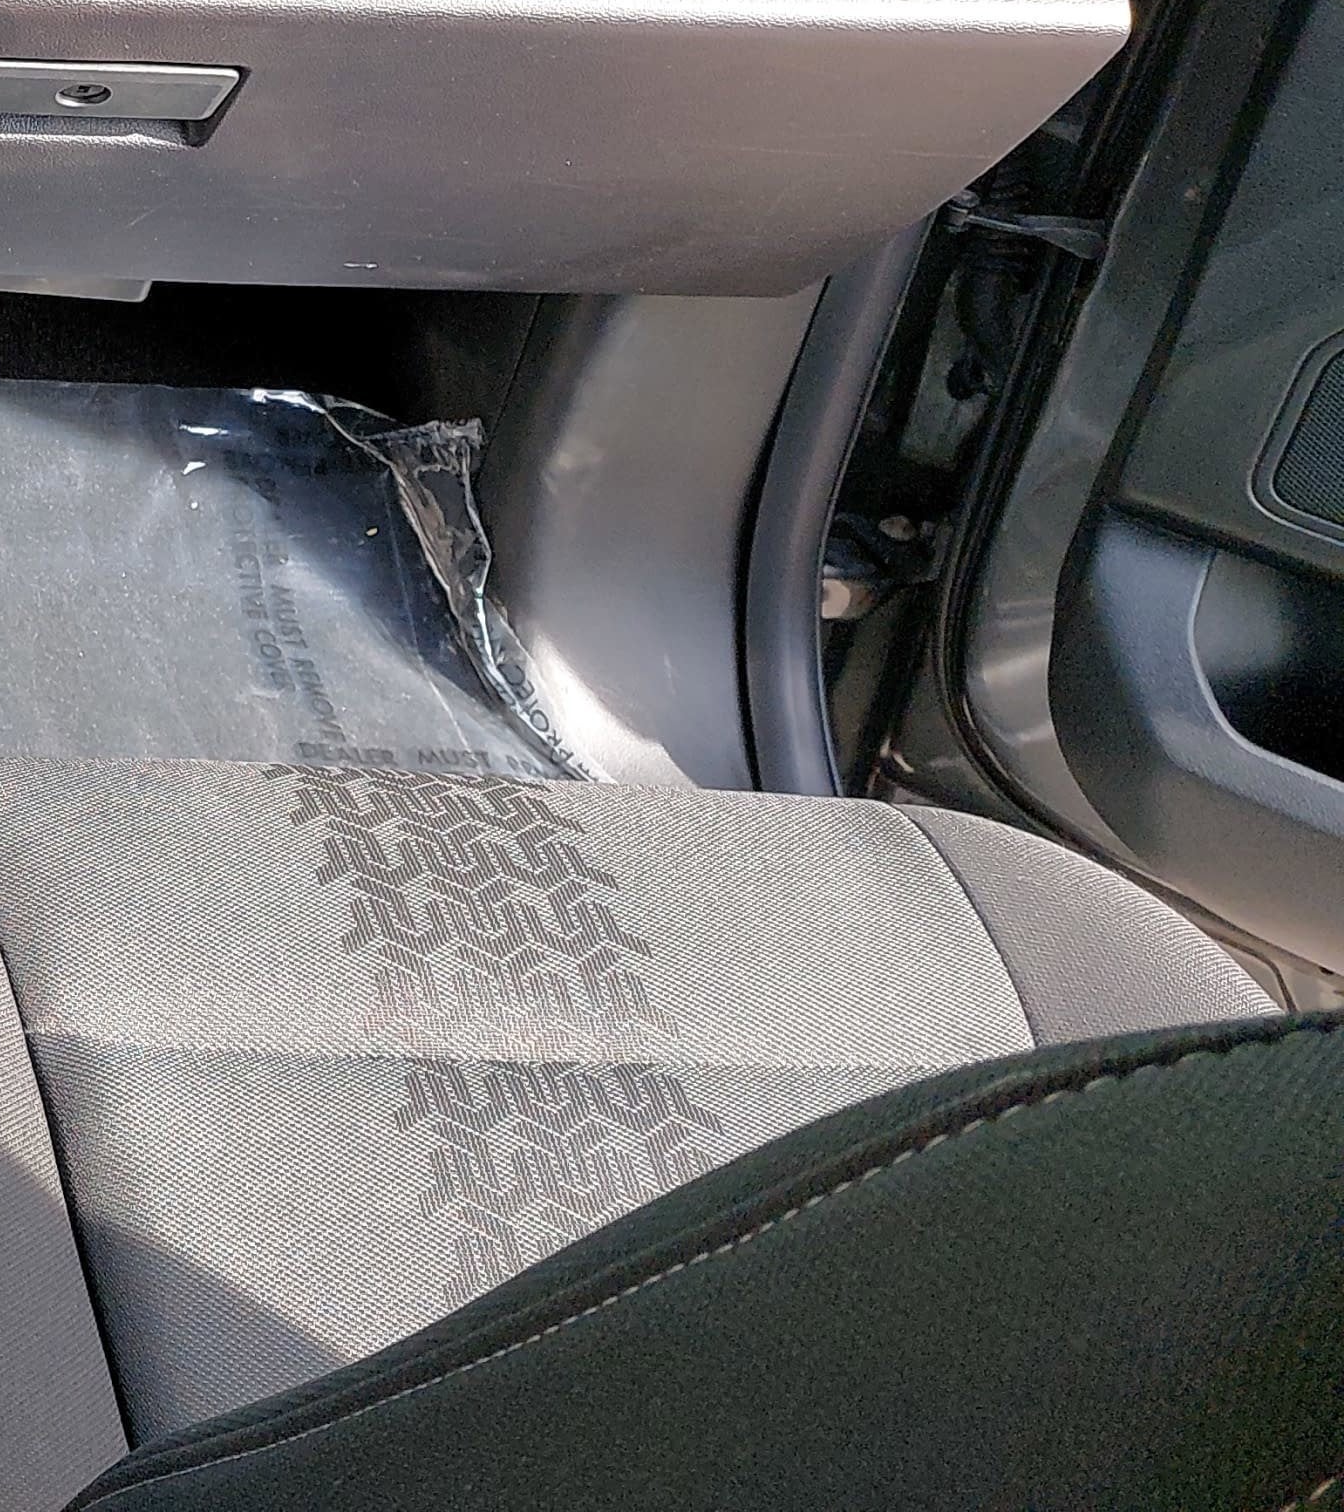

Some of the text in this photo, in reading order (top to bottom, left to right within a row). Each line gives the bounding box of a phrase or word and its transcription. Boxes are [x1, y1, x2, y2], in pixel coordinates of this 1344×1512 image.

[270, 584, 309, 650] MUST
[293, 740, 398, 766] DEALER
[418, 746, 491, 772] MUST
